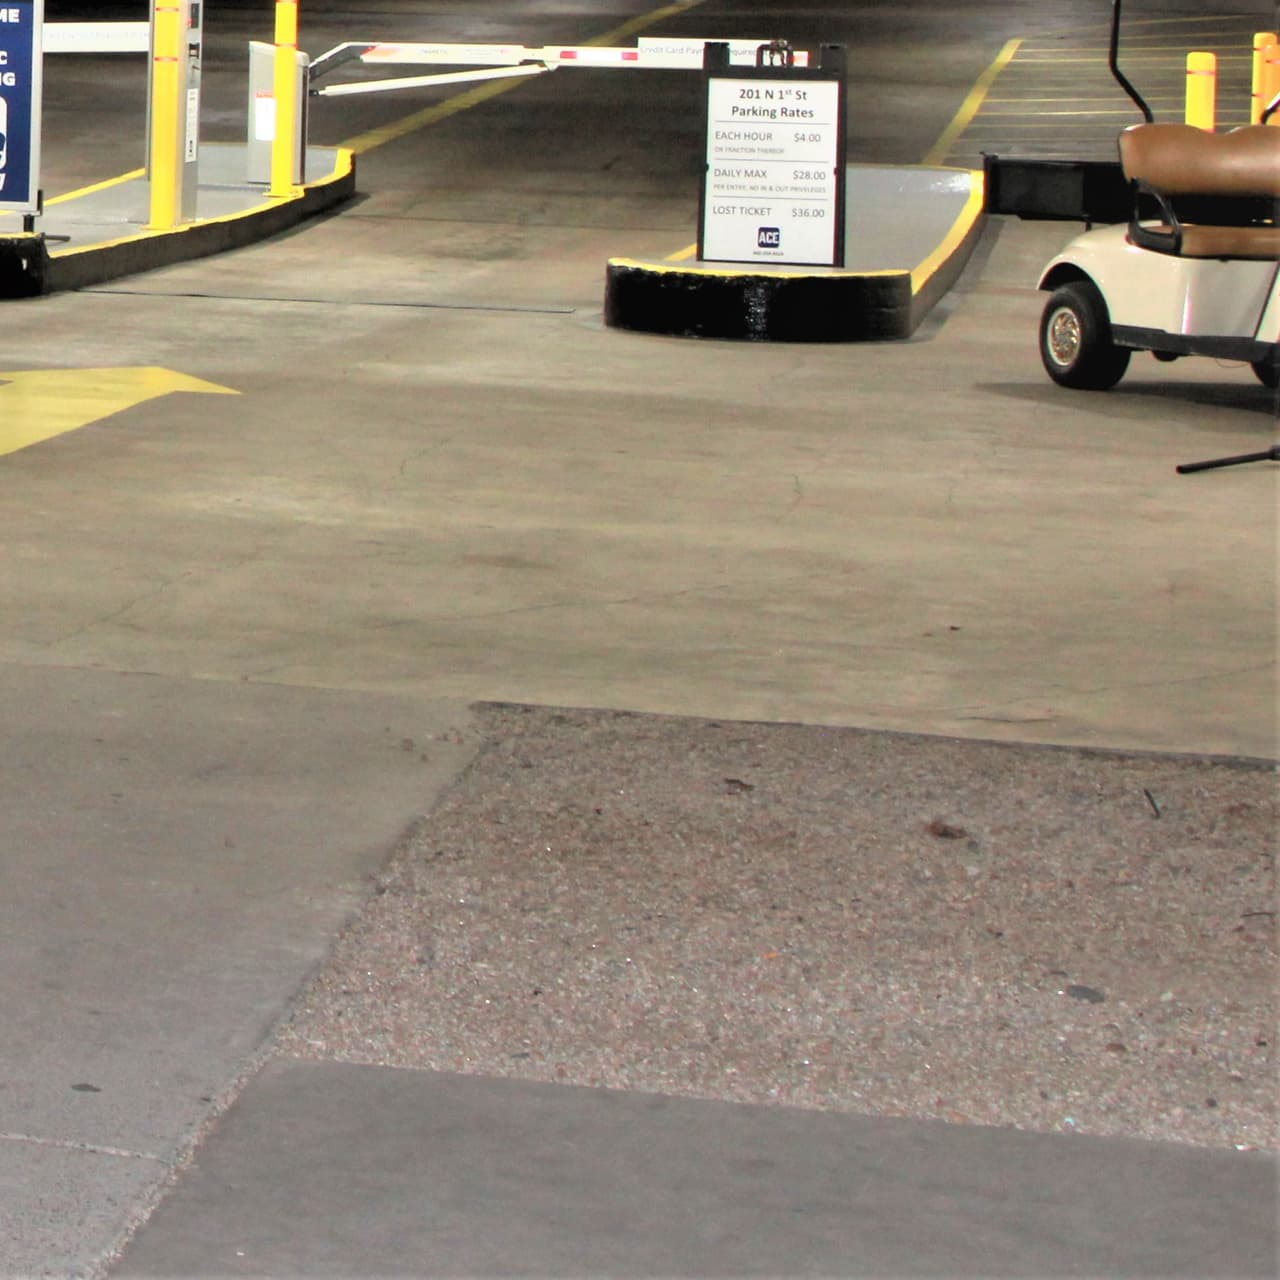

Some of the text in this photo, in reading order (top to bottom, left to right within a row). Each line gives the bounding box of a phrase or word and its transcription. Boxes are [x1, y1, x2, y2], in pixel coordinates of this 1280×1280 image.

[739, 88, 761, 99] 201
[765, 88, 774, 100] N
[795, 90, 808, 101] St
[731, 105, 815, 119] Parking Rates
[715, 131, 821, 143] EACH HOUR $4.00
[714, 168, 826, 180] DAILY MAX $28.00
[712, 206, 825, 218] LOST TICKET $36.00
[759, 231, 780, 245] ACE
